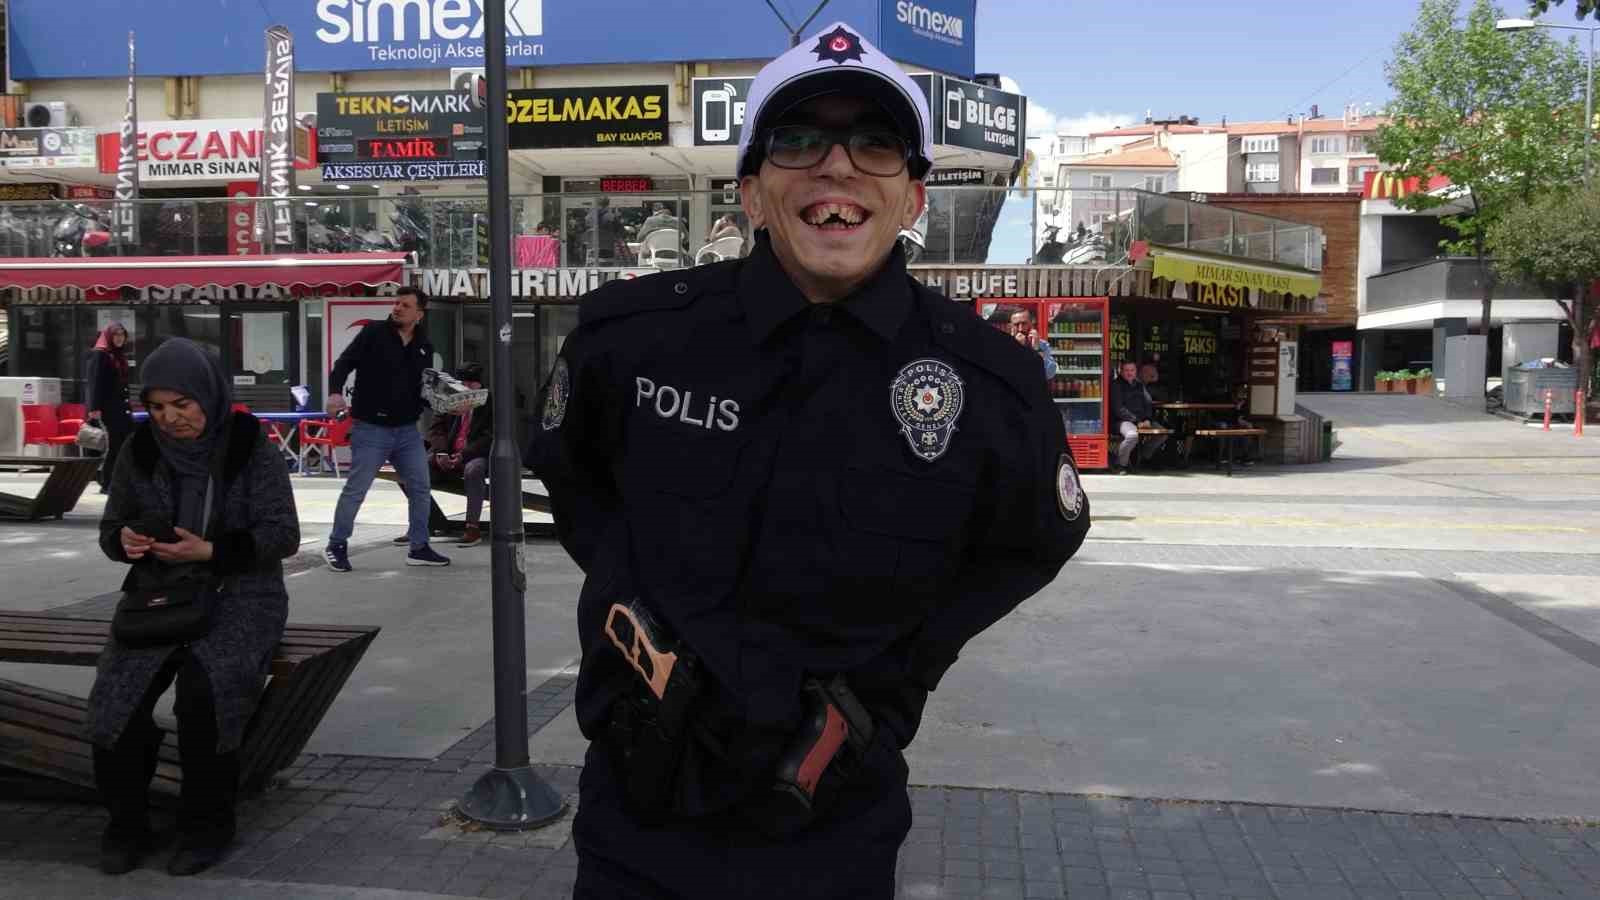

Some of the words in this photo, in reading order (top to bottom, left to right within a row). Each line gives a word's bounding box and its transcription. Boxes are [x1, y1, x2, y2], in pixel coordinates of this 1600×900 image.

[896, 2, 952, 37] simex
[368, 44, 441, 63] Teknoloji
[336, 94, 472, 115] TEKNOMARK
[376, 118, 430, 135] İLETİŞİM
[370, 137, 436, 158] TAMİR
[596, 132, 617, 143] BAY
[323, 162, 403, 180] AKSESUAR
[407, 159, 485, 183] ÇEŞİTLERİ
[957, 271, 1018, 294] BÜFE
